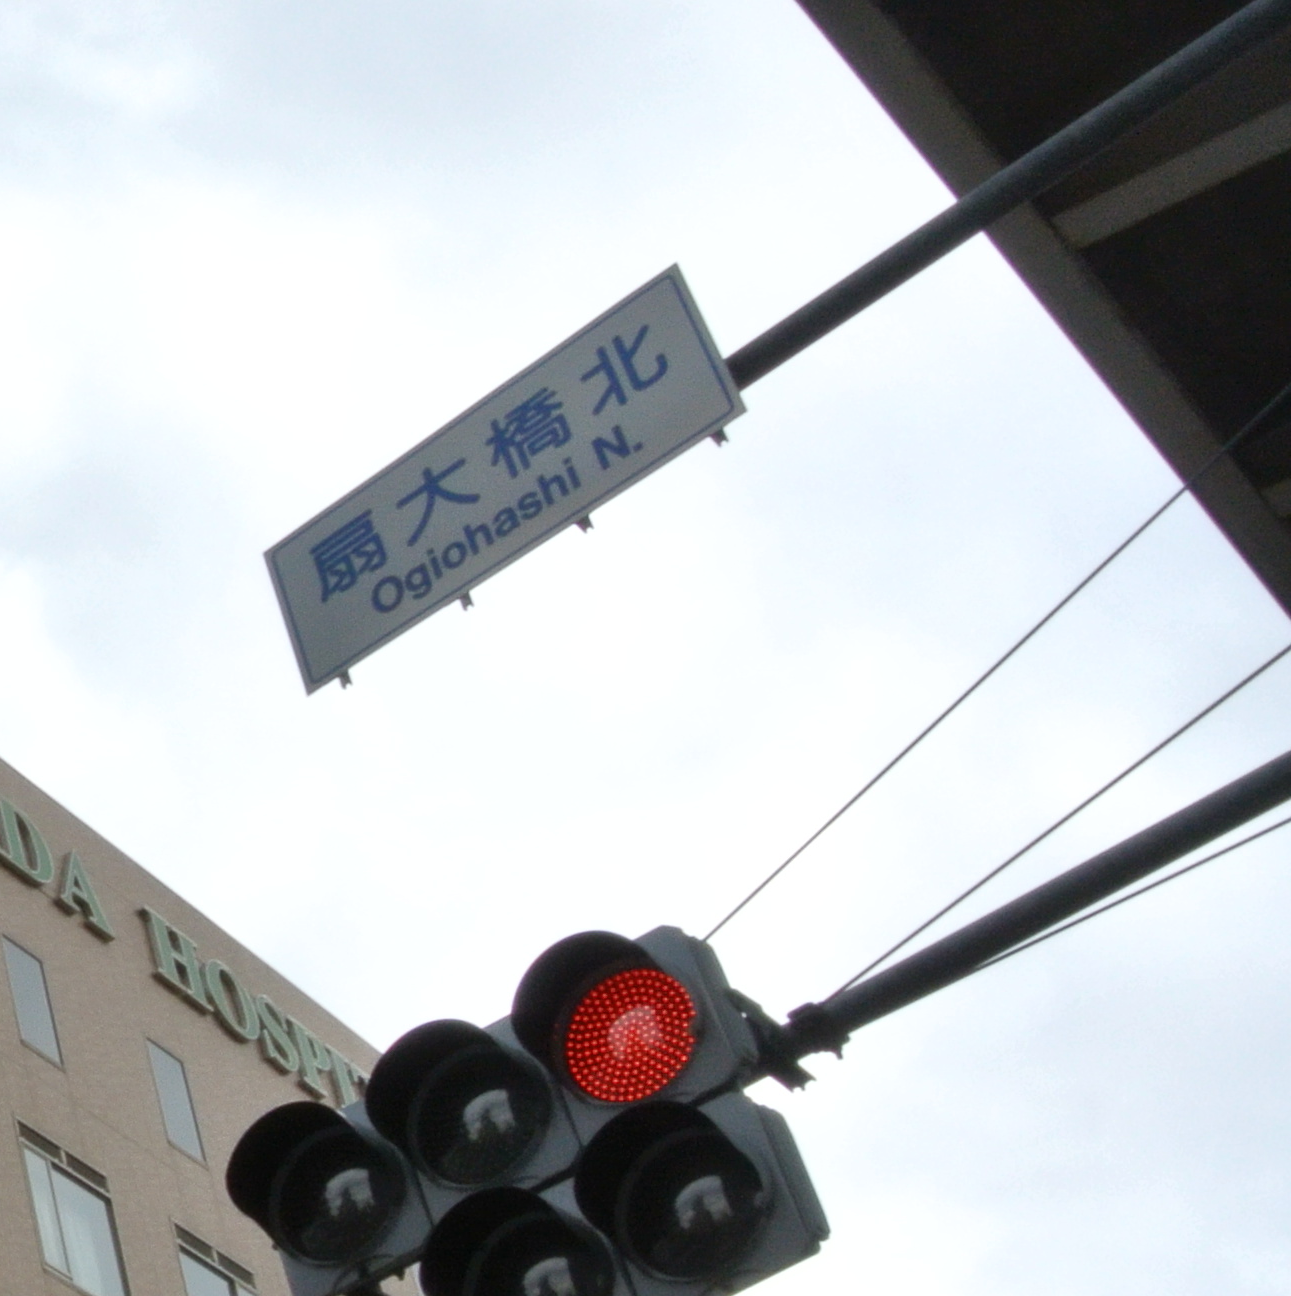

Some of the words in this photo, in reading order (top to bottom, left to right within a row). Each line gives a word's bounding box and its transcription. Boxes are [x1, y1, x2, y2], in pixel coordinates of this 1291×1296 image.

[309, 324, 668, 603] 扇大橋北
[371, 457, 581, 614] Ogiohashi
[593, 424, 644, 471] N.
[141, 904, 370, 1108] HOSPI
